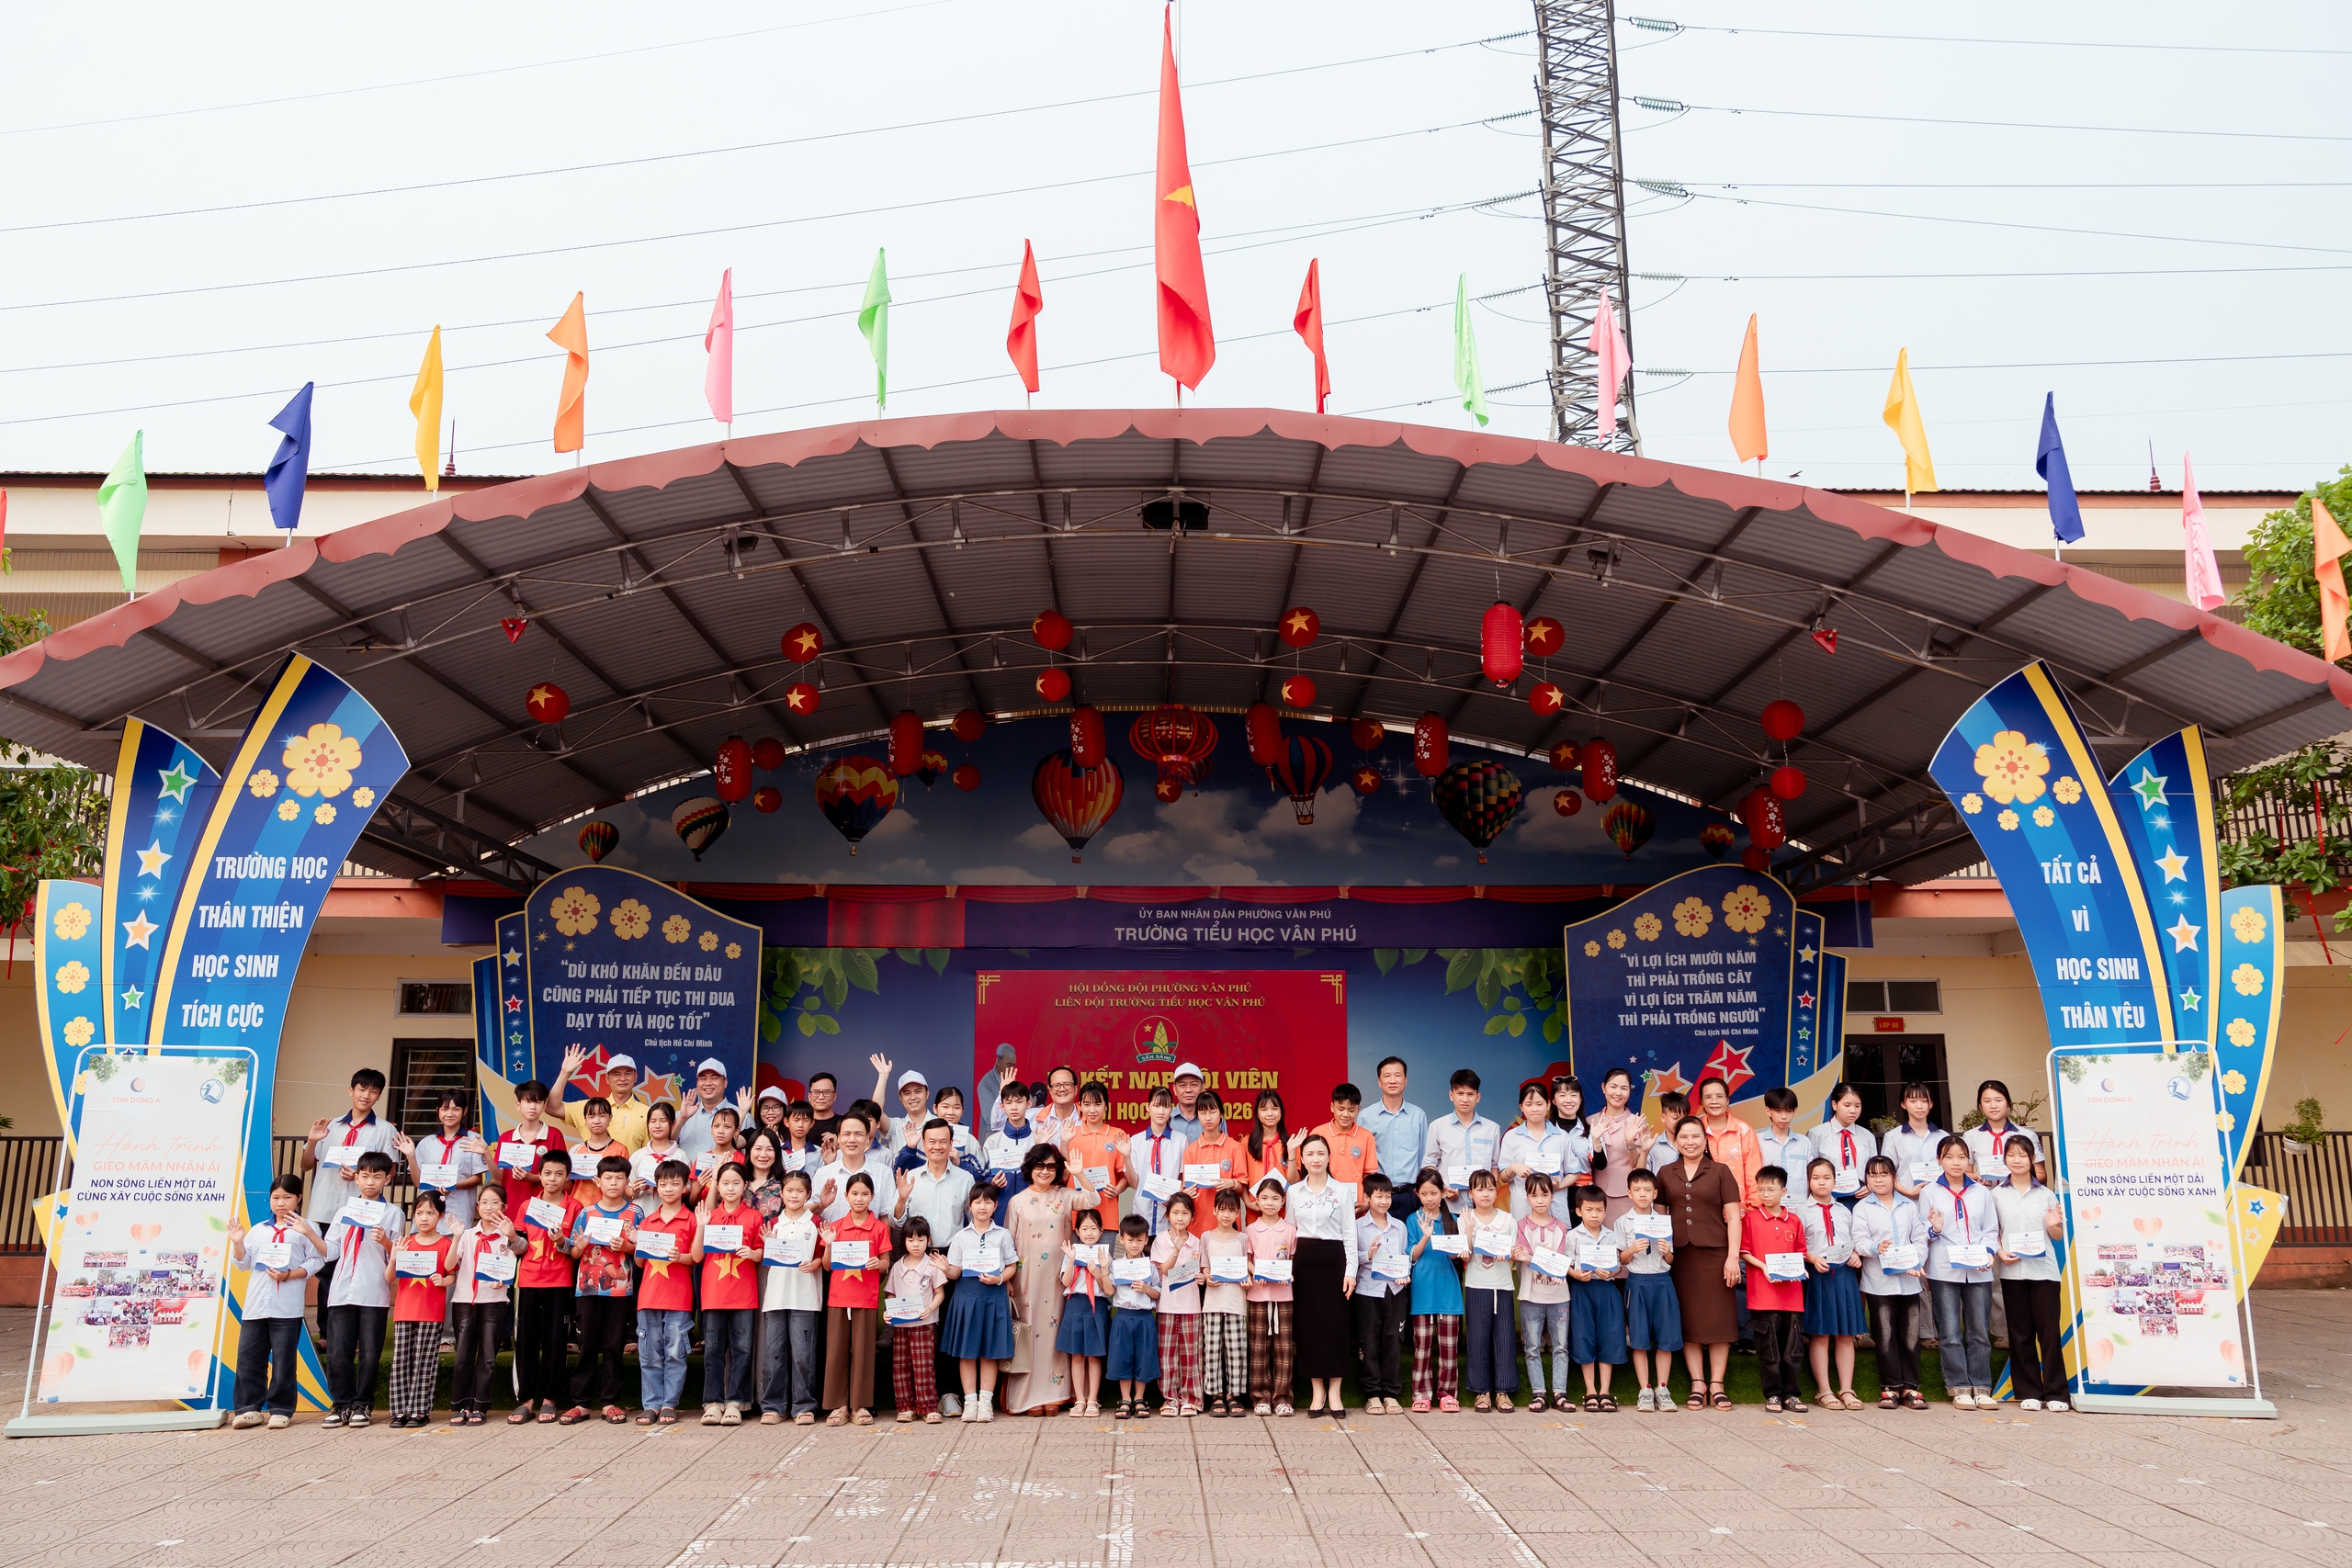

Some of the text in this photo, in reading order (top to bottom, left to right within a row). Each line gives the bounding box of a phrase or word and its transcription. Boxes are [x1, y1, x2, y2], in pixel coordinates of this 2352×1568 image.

[215, 851, 328, 884] TRƯỜNG HỌC
[2041, 855, 2101, 883] TẤT CẢ
[199, 901, 304, 933] THÂN THIỆN
[1139, 907, 1153, 918] ỦY
[1181, 908, 1210, 918] NHÂN
[1213, 908, 1235, 918] DÂN
[1238, 908, 1282, 918] PHƯỜNG
[1286, 908, 1306, 918] VÂN
[1310, 908, 1331, 918] PHÚ
[2072, 905, 2090, 931] VÌ
[1115, 920, 1356, 944] TRƯỜNG TIỂU HỌC VÂN PHÚ
[192, 954, 279, 982] HỌC SINH
[1643, 954, 1662, 969] LỢI
[1666, 952, 1686, 966] ÍCH
[1690, 951, 1723, 965] MƯỜI
[1727, 950, 1756, 964] NĂM
[590, 962, 619, 979] KHÓ
[623, 963, 660, 980] KHĂN
[664, 962, 690, 981] ĐẾN
[695, 965, 722, 982] ĐÂU
[1627, 969, 1752, 987] THÌ PHẢI TRỒNG CÂY
[2056, 958, 2139, 985] HỌC SINH
[543, 985, 735, 1007] CŨNG PHẢI TIẾP TỤC THI ĐUA
[1069, 981, 1251, 994] HỘI ĐỒNG ĐỘI PHƯỜNG VÂN PHÚ
[1055, 995, 1265, 1008] LIÊN ĐỘI TRƯỜNG TIỂU HỌC VÂN PHÚ
[1624, 989, 1757, 1008] VÌ LỢI ÍCH TRĂM NĂM
[182, 998, 264, 1033] TÍCH CỰC
[566, 1013, 594, 1031] DẠY
[598, 1009, 622, 1028] TỐT
[626, 1012, 643, 1029] VÀ
[647, 1014, 674, 1032] HỌC
[1618, 1012, 1638, 1026] THÌ
[1642, 1010, 1670, 1025] PHẢI
[1674, 1009, 1716, 1024] TRỒNG
[2061, 1001, 2145, 1028] THÂN YÊU
[645, 1038, 657, 1047] Chủ
[659, 1039, 671, 1048] tịch
[673, 1038, 682, 1047] Hồ
[684, 1039, 694, 1047] Chí
[1225, 1067, 1278, 1089] VIÊN
[1117, 1102, 1150, 1123] HỌC
[93, 1129, 162, 1160] Hành
[2080, 1128, 2144, 1158] Hành
[93, 1159, 220, 1172] GIEO MẦM NHÂN ÁI
[2085, 1156, 2204, 1168] GIEO MẦM NHÂN ÁI
[91, 1179, 114, 1187] NON
[116, 1177, 145, 1188] SÔNG
[148, 1177, 172, 1188] LIỀN
[174, 1178, 196, 1191] MỘT
[2110, 1173, 2136, 1183] SÔNG
[2139, 1172, 2161, 1183] LIỀN
[2164, 1173, 2184, 1185] MỘT
[77, 1190, 107, 1201] CÙNG
[110, 1190, 130, 1201] XÂY
[133, 1191, 161, 1203] CUỘC
[164, 1190, 193, 1201] SỐNG
[2078, 1184, 2216, 1198] CÙNG XÂY CUỘC SỐNG XANH
